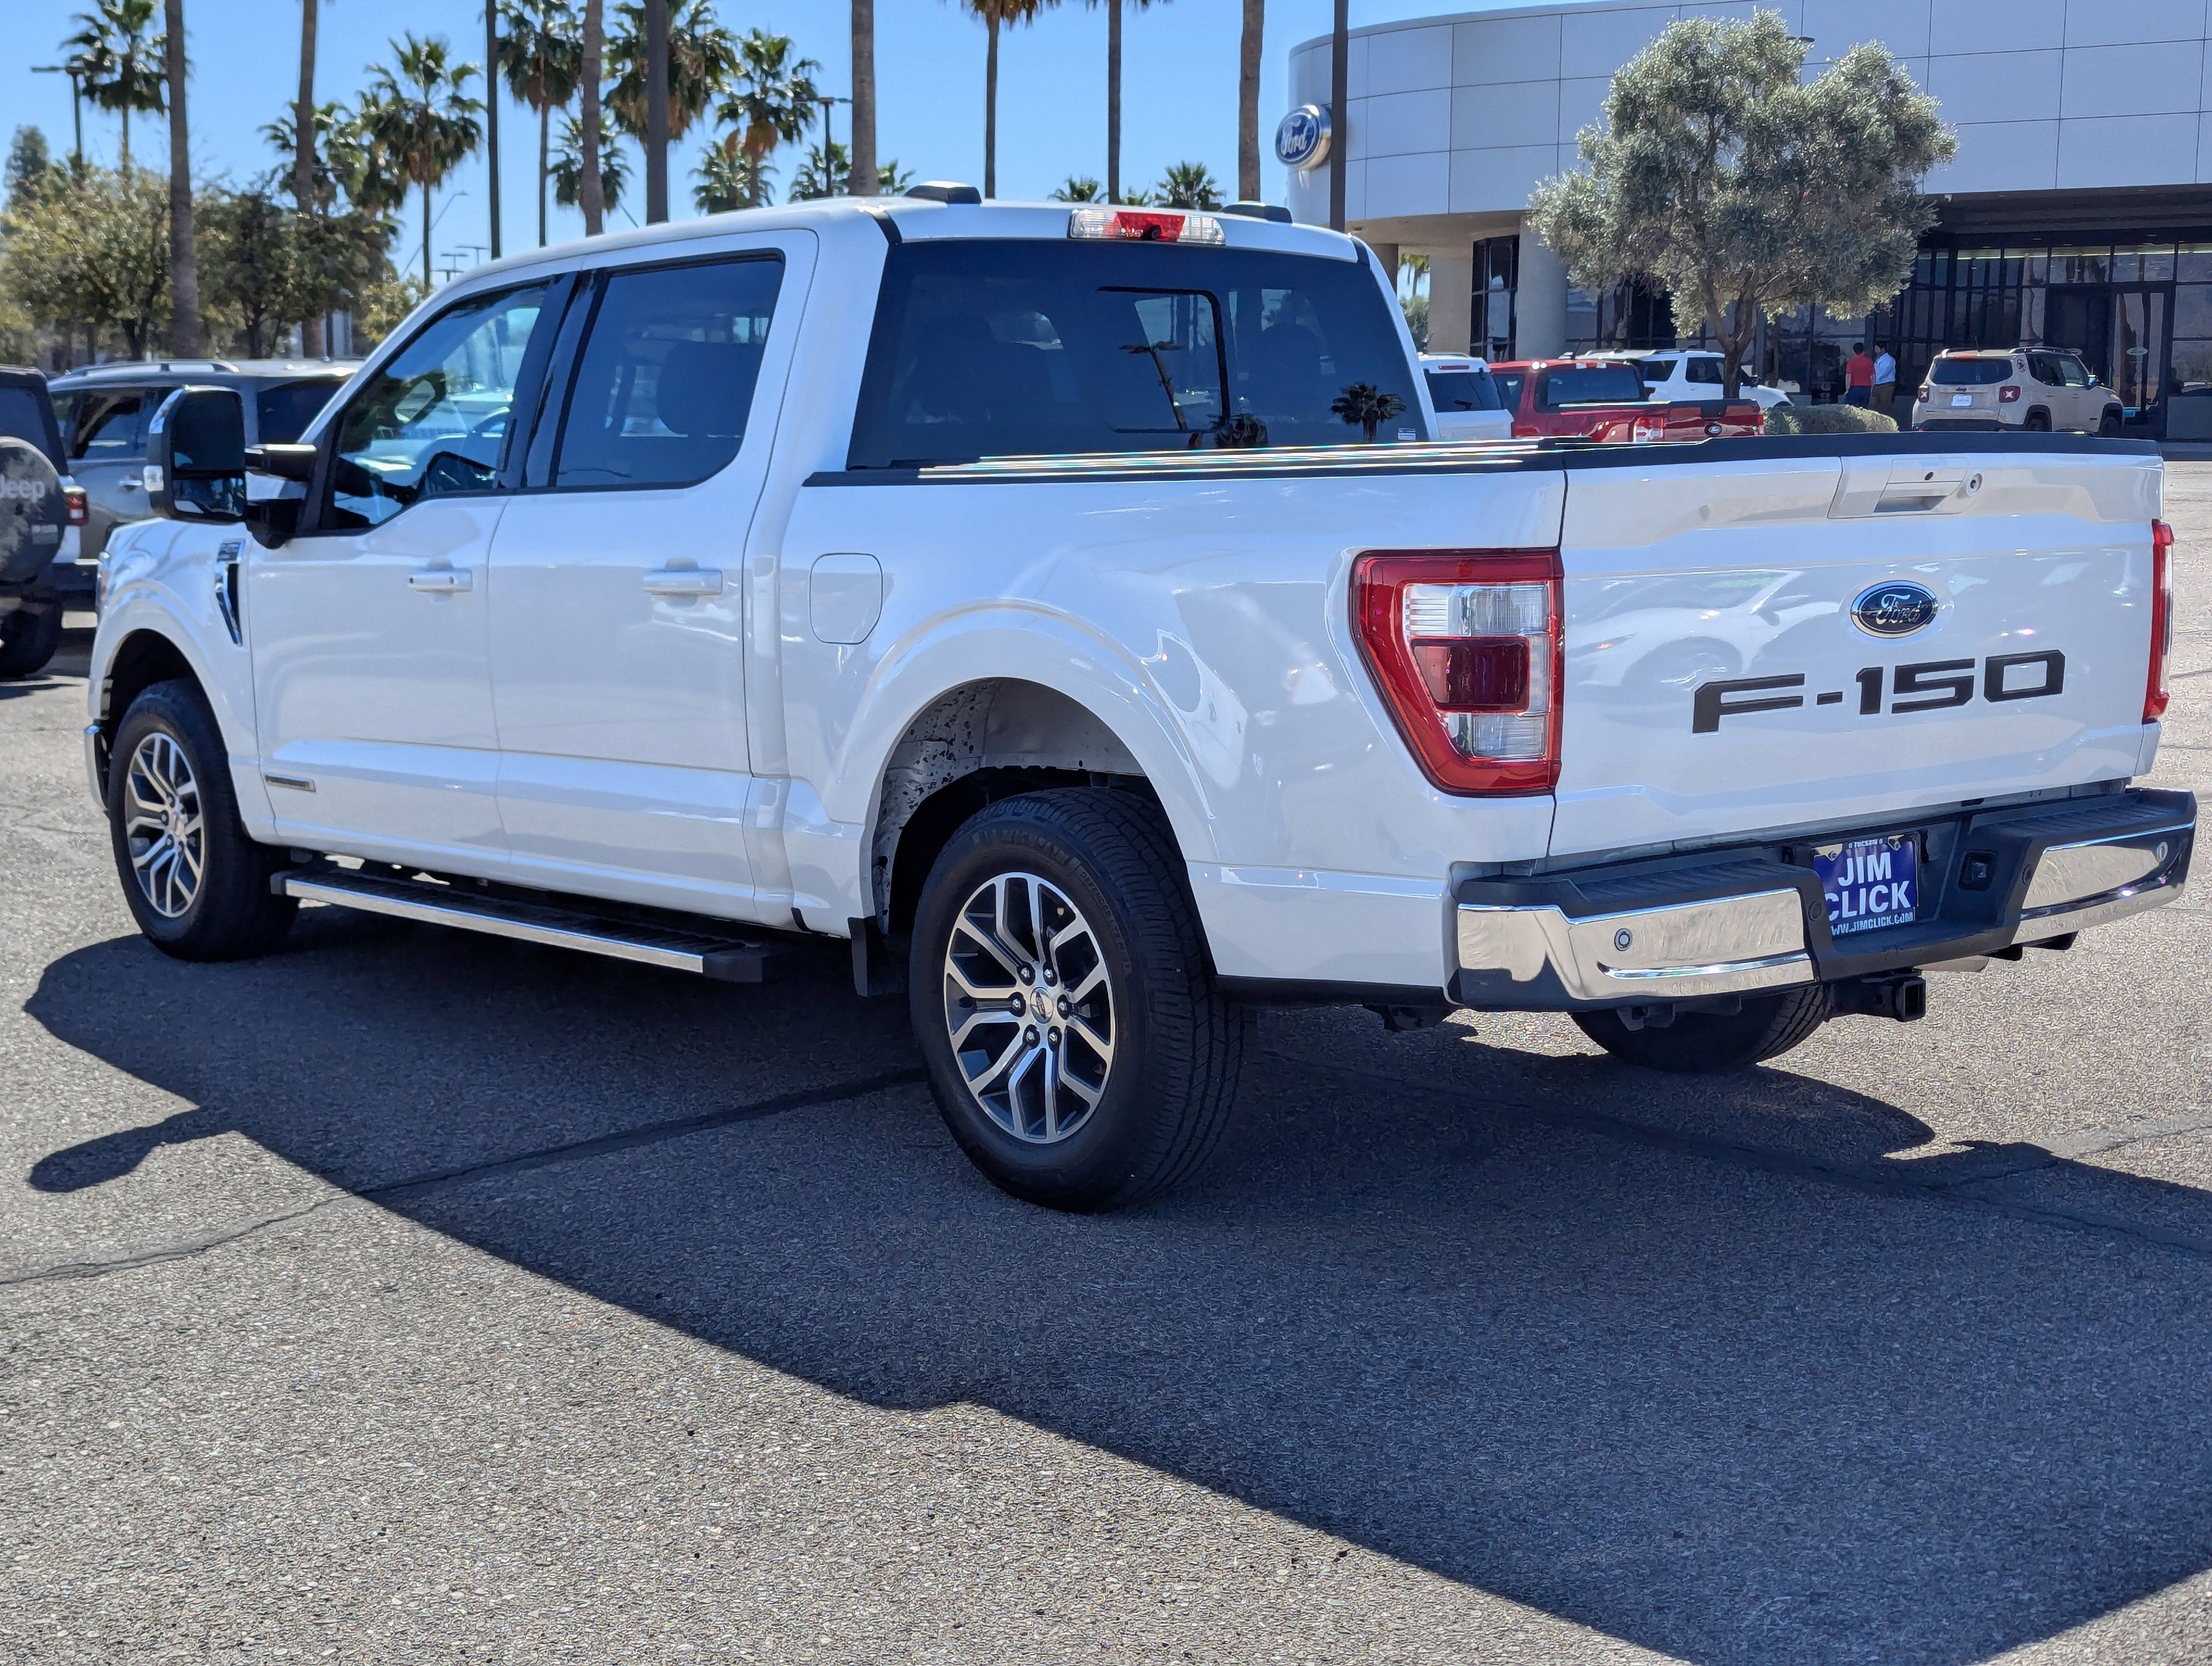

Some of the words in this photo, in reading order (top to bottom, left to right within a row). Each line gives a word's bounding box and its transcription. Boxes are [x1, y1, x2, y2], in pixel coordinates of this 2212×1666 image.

[1281, 119, 1308, 156] Ford
[1875, 593, 1922, 625] Ford
[1692, 649, 2066, 733] F-150
[1837, 852, 1892, 887] JIM
[1825, 880, 1911, 921] CLICK
